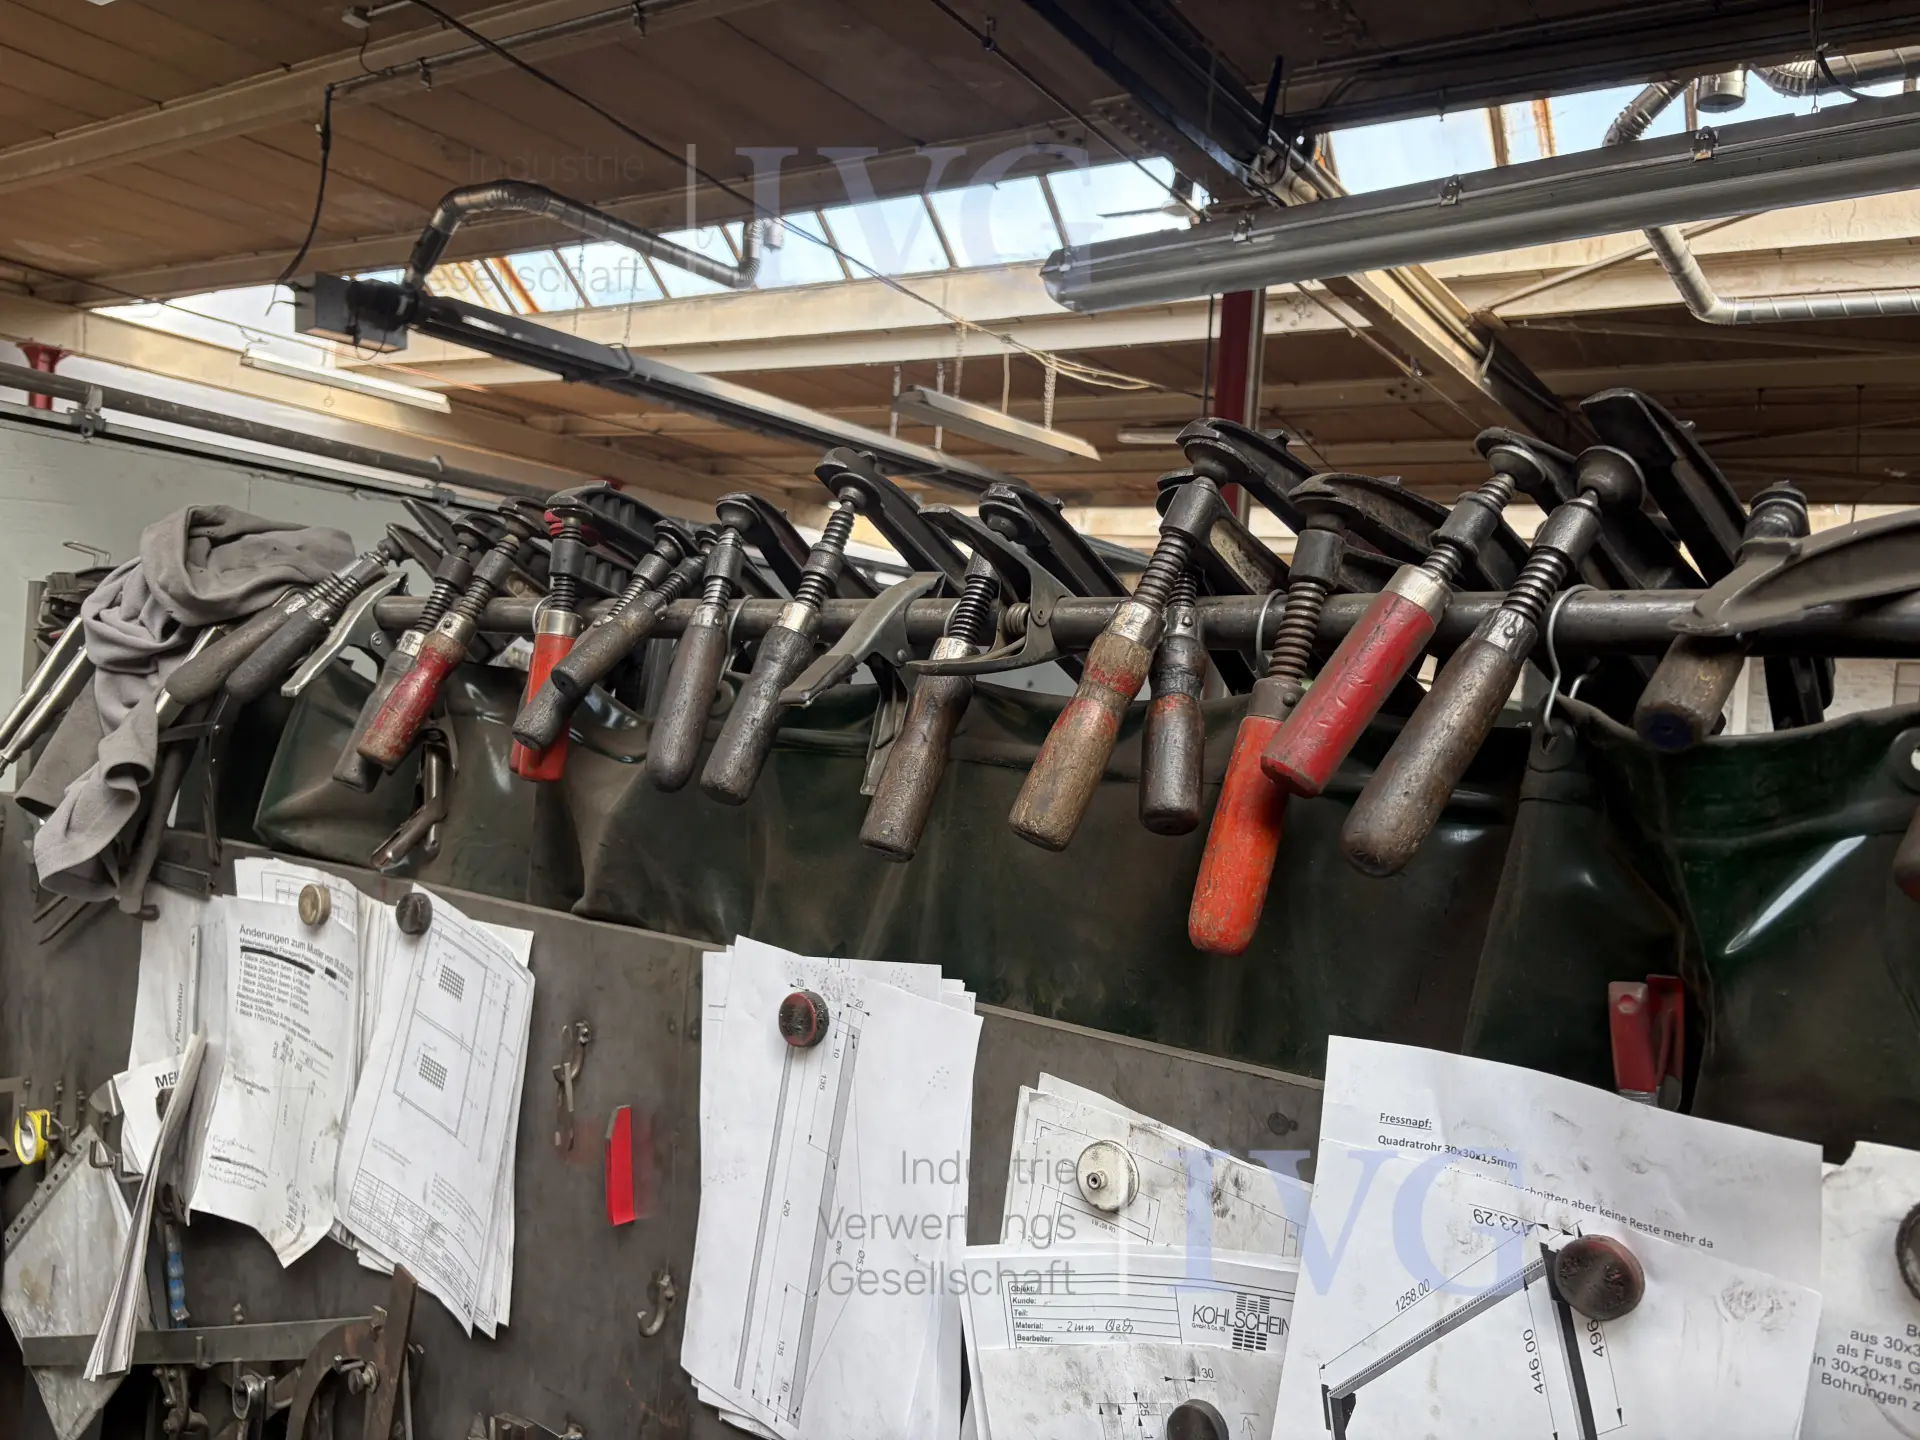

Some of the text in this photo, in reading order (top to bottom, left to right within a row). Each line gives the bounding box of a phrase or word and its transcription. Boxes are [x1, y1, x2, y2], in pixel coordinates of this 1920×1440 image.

[240, 924, 289, 944] Änderungen
[1379, 1112, 1433, 1130] Fressnapf:
[1377, 1135, 1518, 1170] Quadratrohr 30x30x1,5mm
[1571, 1200, 1597, 1213] aber
[1599, 1206, 1628, 1224] keine
[1629, 1217, 1660, 1235] Reste
[1663, 1228, 1696, 1244] mehr
[1698, 1237, 1714, 1249] da
[1011, 1285, 1035, 1295] Objekt:
[1395, 1278, 1431, 1313] 1258.00
[1012, 1297, 1037, 1305] Kunde:
[1013, 1309, 1028, 1317] Teil:
[1015, 1322, 1044, 1330] Material:
[1016, 1335, 1053, 1343] Bearbeiter:
[1849, 1329, 1879, 1346] aus
[1522, 1328, 1544, 1395] 446.00
[1812, 1352, 1826, 1368] in
[1836, 1344, 1859, 1359] als
[1863, 1348, 1903, 1370] Fuss
[1201, 1368, 1214, 1379] 30
[1821, 1371, 1908, 1408] Bohrungen
[1138, 1401, 1150, 1417] 25
